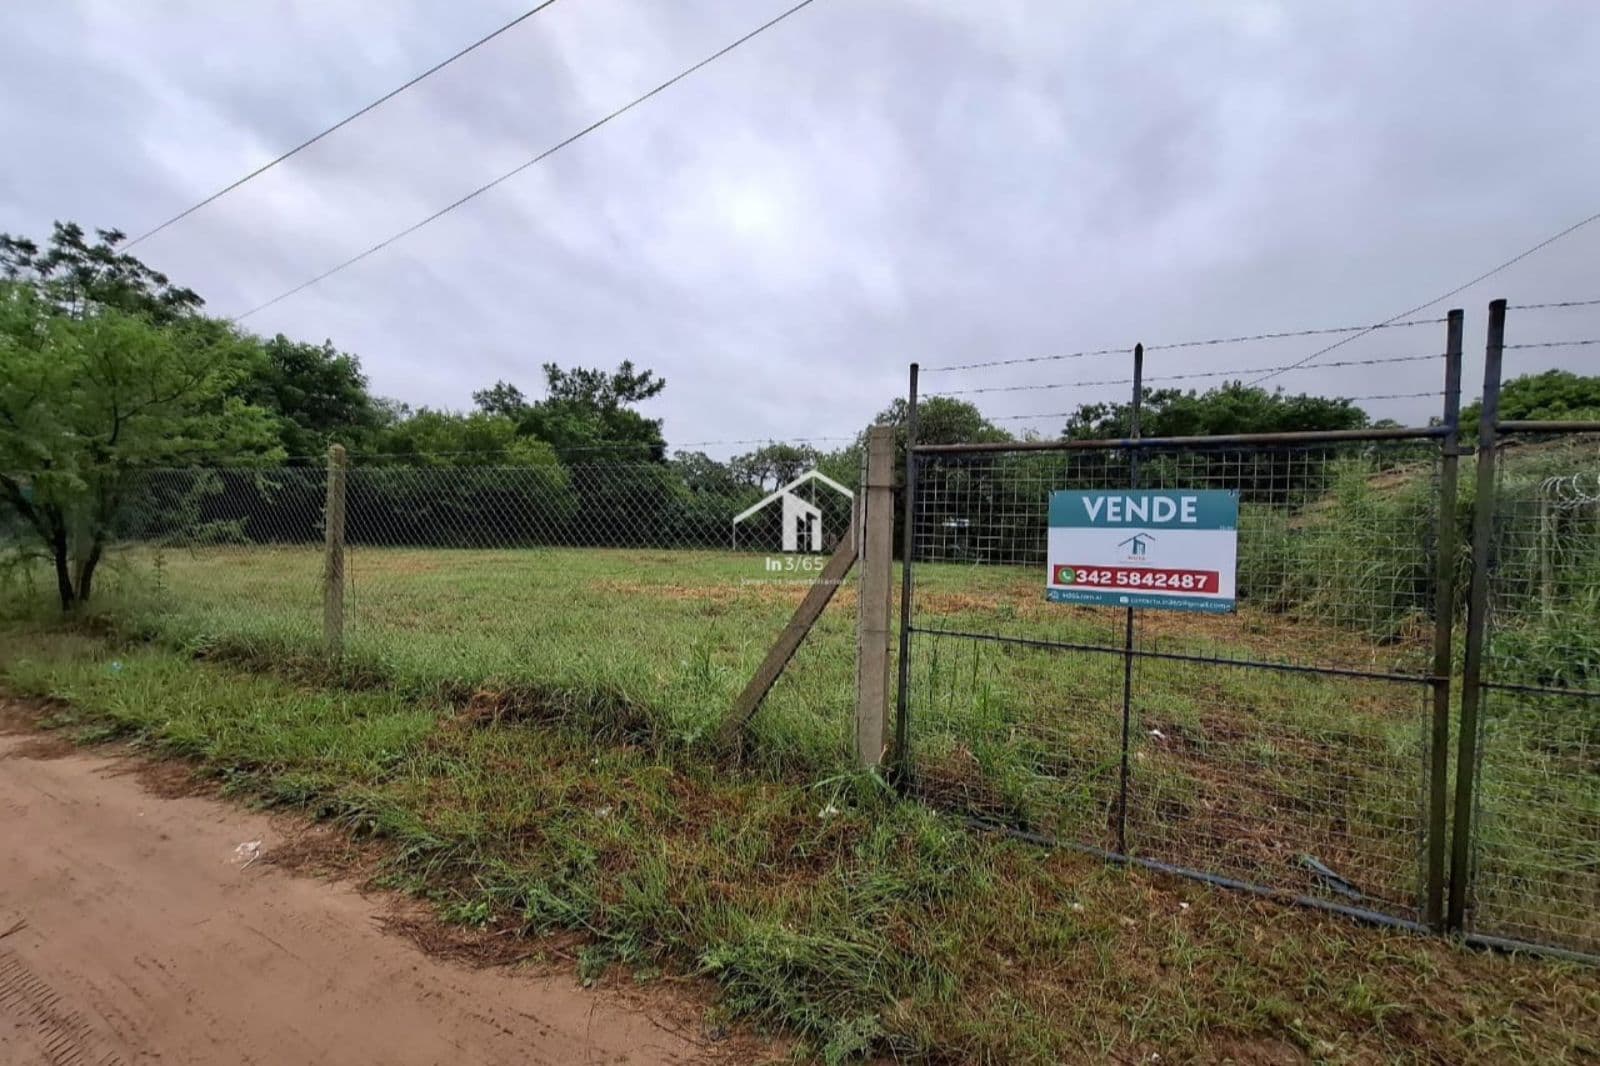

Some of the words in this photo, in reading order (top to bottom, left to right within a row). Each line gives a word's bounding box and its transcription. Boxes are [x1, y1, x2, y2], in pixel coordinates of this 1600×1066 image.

[1082, 496, 1197, 523] VENDE
[1076, 569, 1112, 584] 342
[1116, 571, 1208, 589] 5842487
